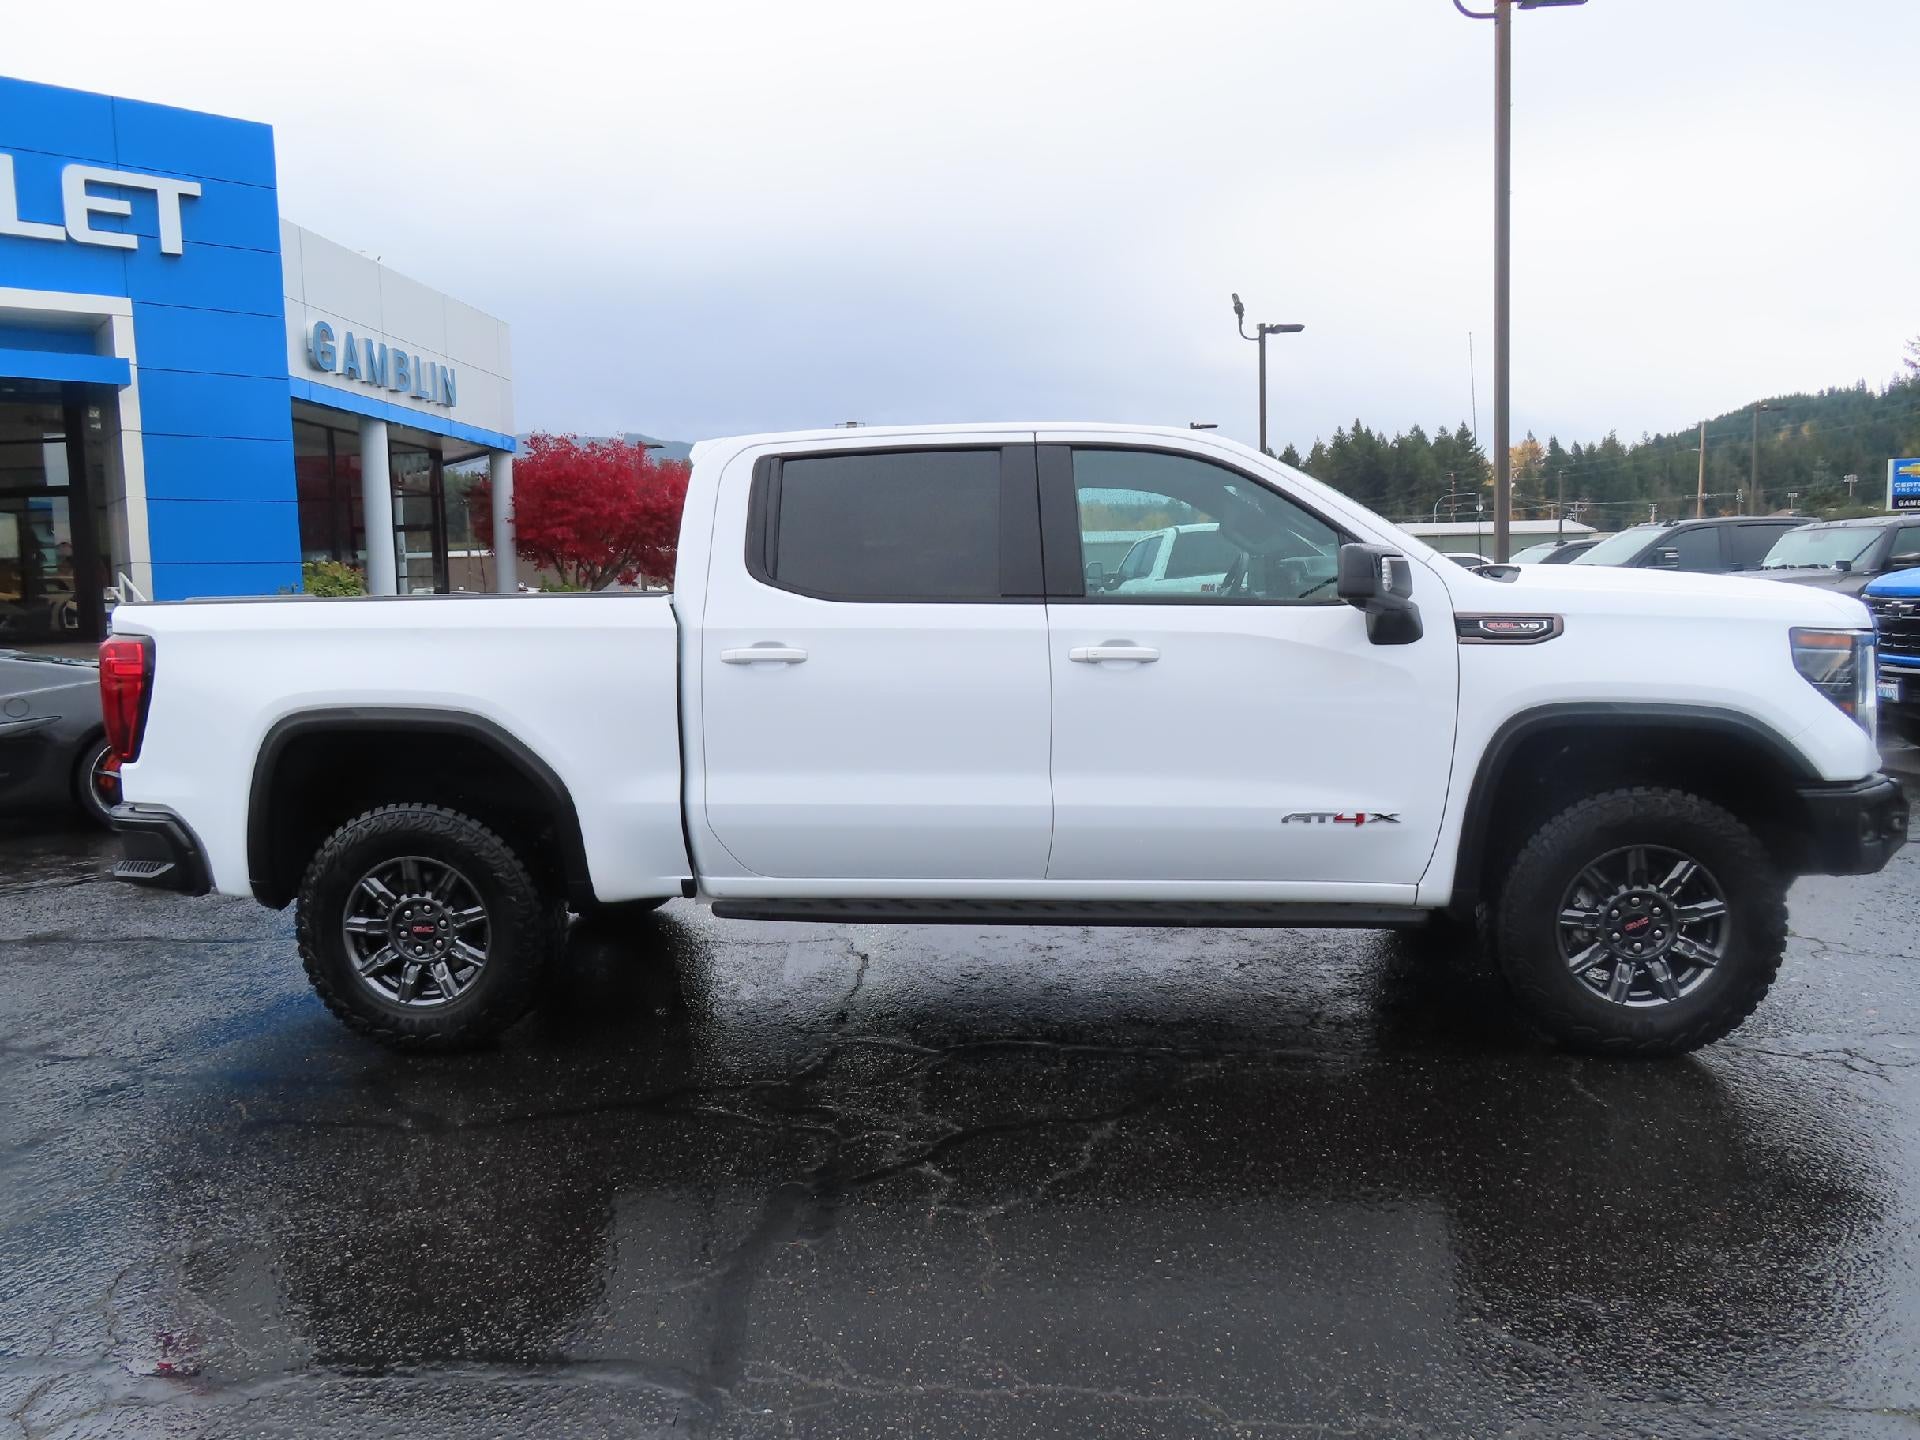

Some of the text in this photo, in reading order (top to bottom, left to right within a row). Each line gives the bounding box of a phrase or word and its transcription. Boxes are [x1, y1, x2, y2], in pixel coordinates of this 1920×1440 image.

[311, 320, 456, 407] GAMBLIN
[1280, 812, 1401, 827] AT4X
[1624, 916, 1649, 931] GMC
